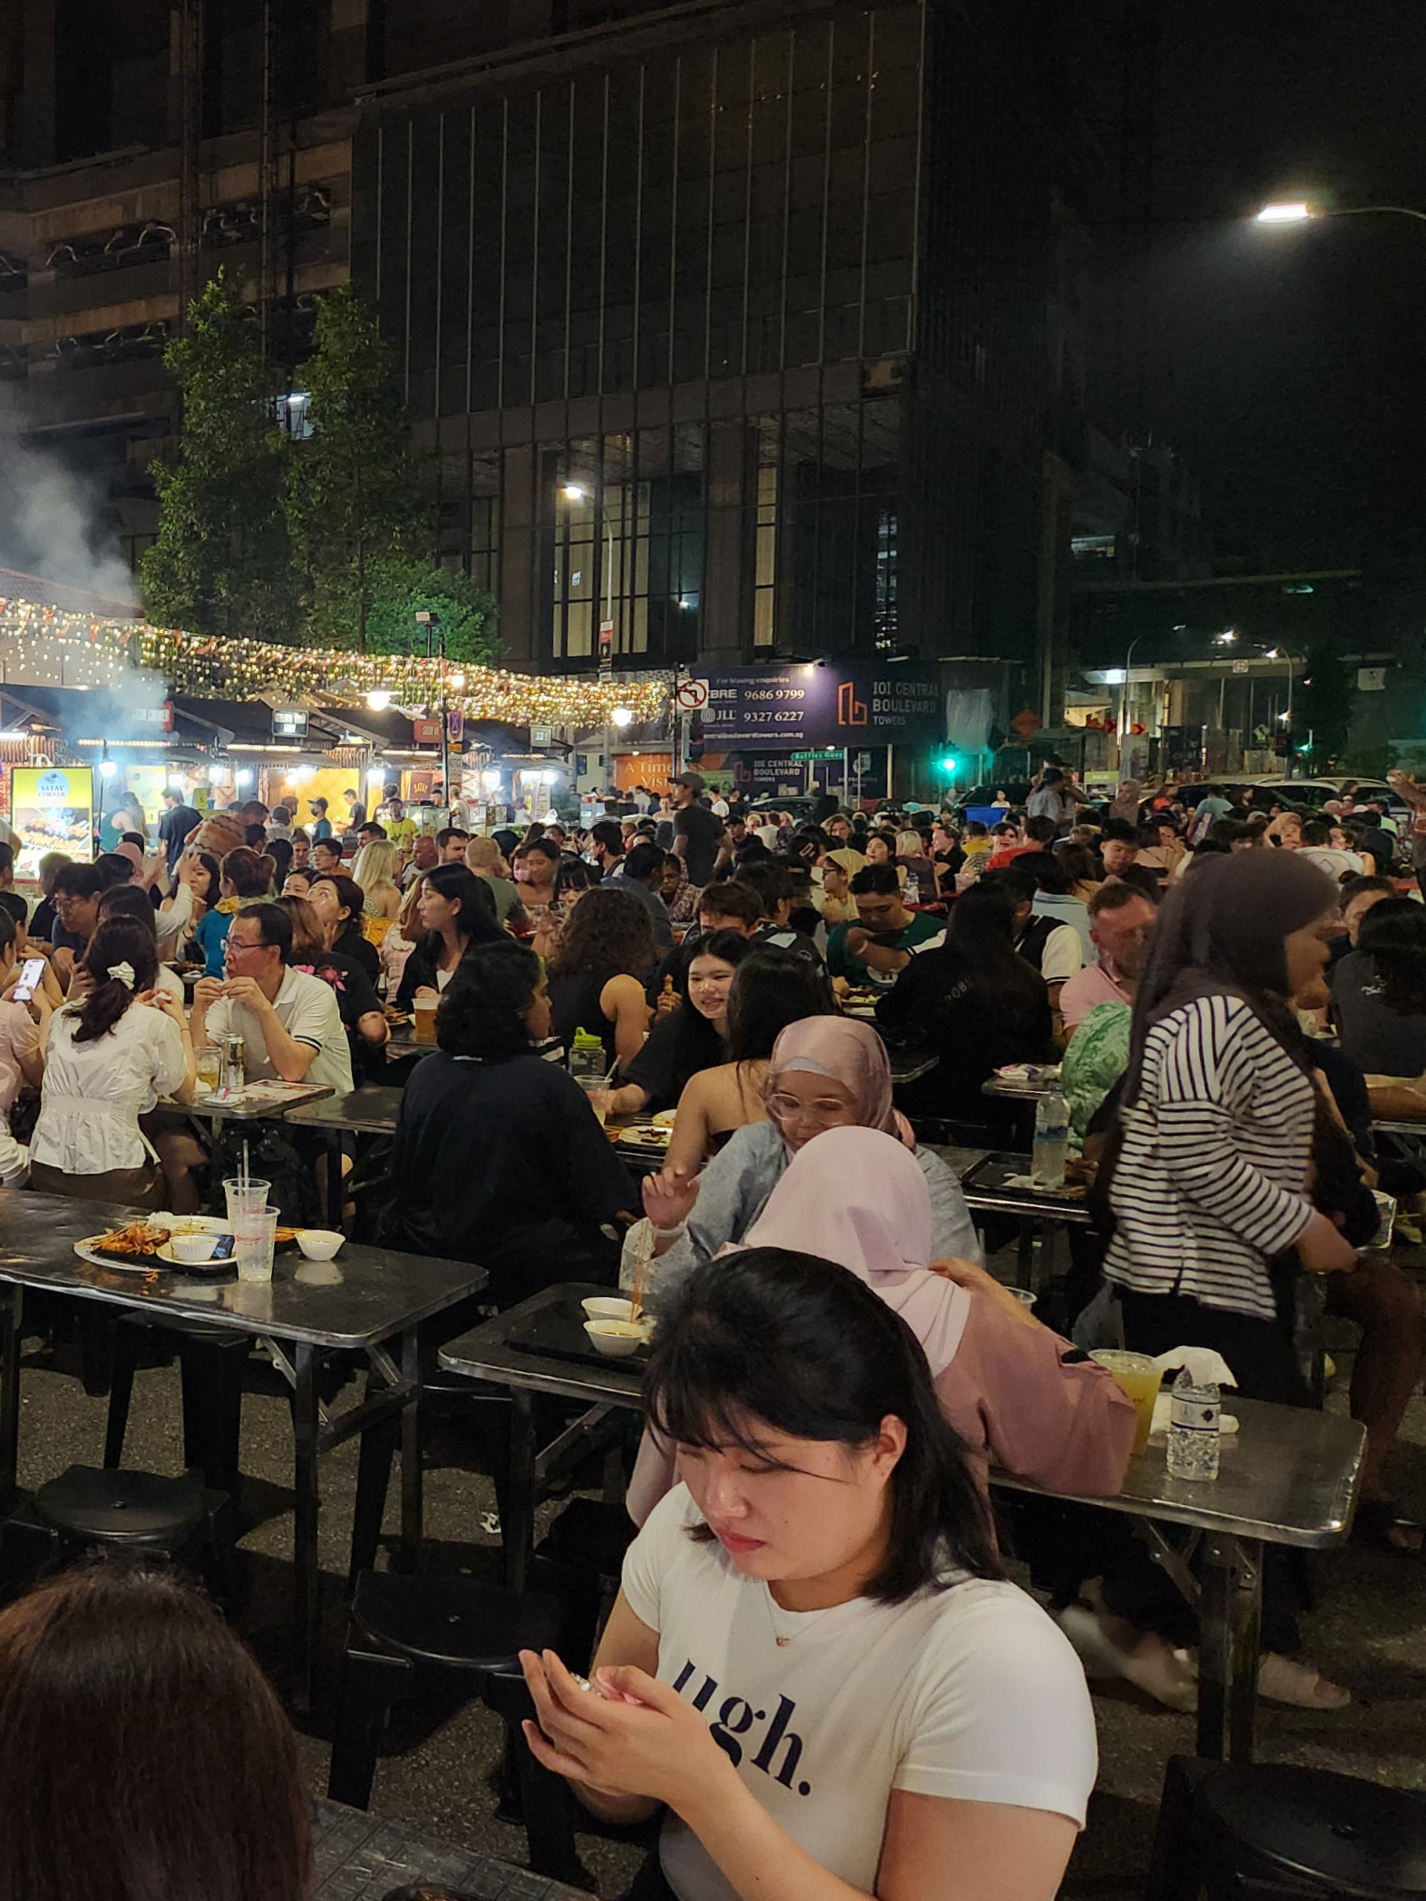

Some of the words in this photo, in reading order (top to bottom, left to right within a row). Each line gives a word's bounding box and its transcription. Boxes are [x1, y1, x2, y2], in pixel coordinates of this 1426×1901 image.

[744, 689, 774, 700] 9686
[775, 689, 805, 700] 9799
[873, 681, 892, 695] IOI
[895, 682, 940, 697] CENTRAL
[872, 698, 936, 714] BOULEVARD
[743, 712, 773, 722] 9327
[774, 711, 805, 722] 6227
[872, 715, 907, 726] TOWERS
[624, 762, 635, 773] A
[767, 760, 804, 768] CENTRAL
[753, 768, 800, 776] BOULEVARD
